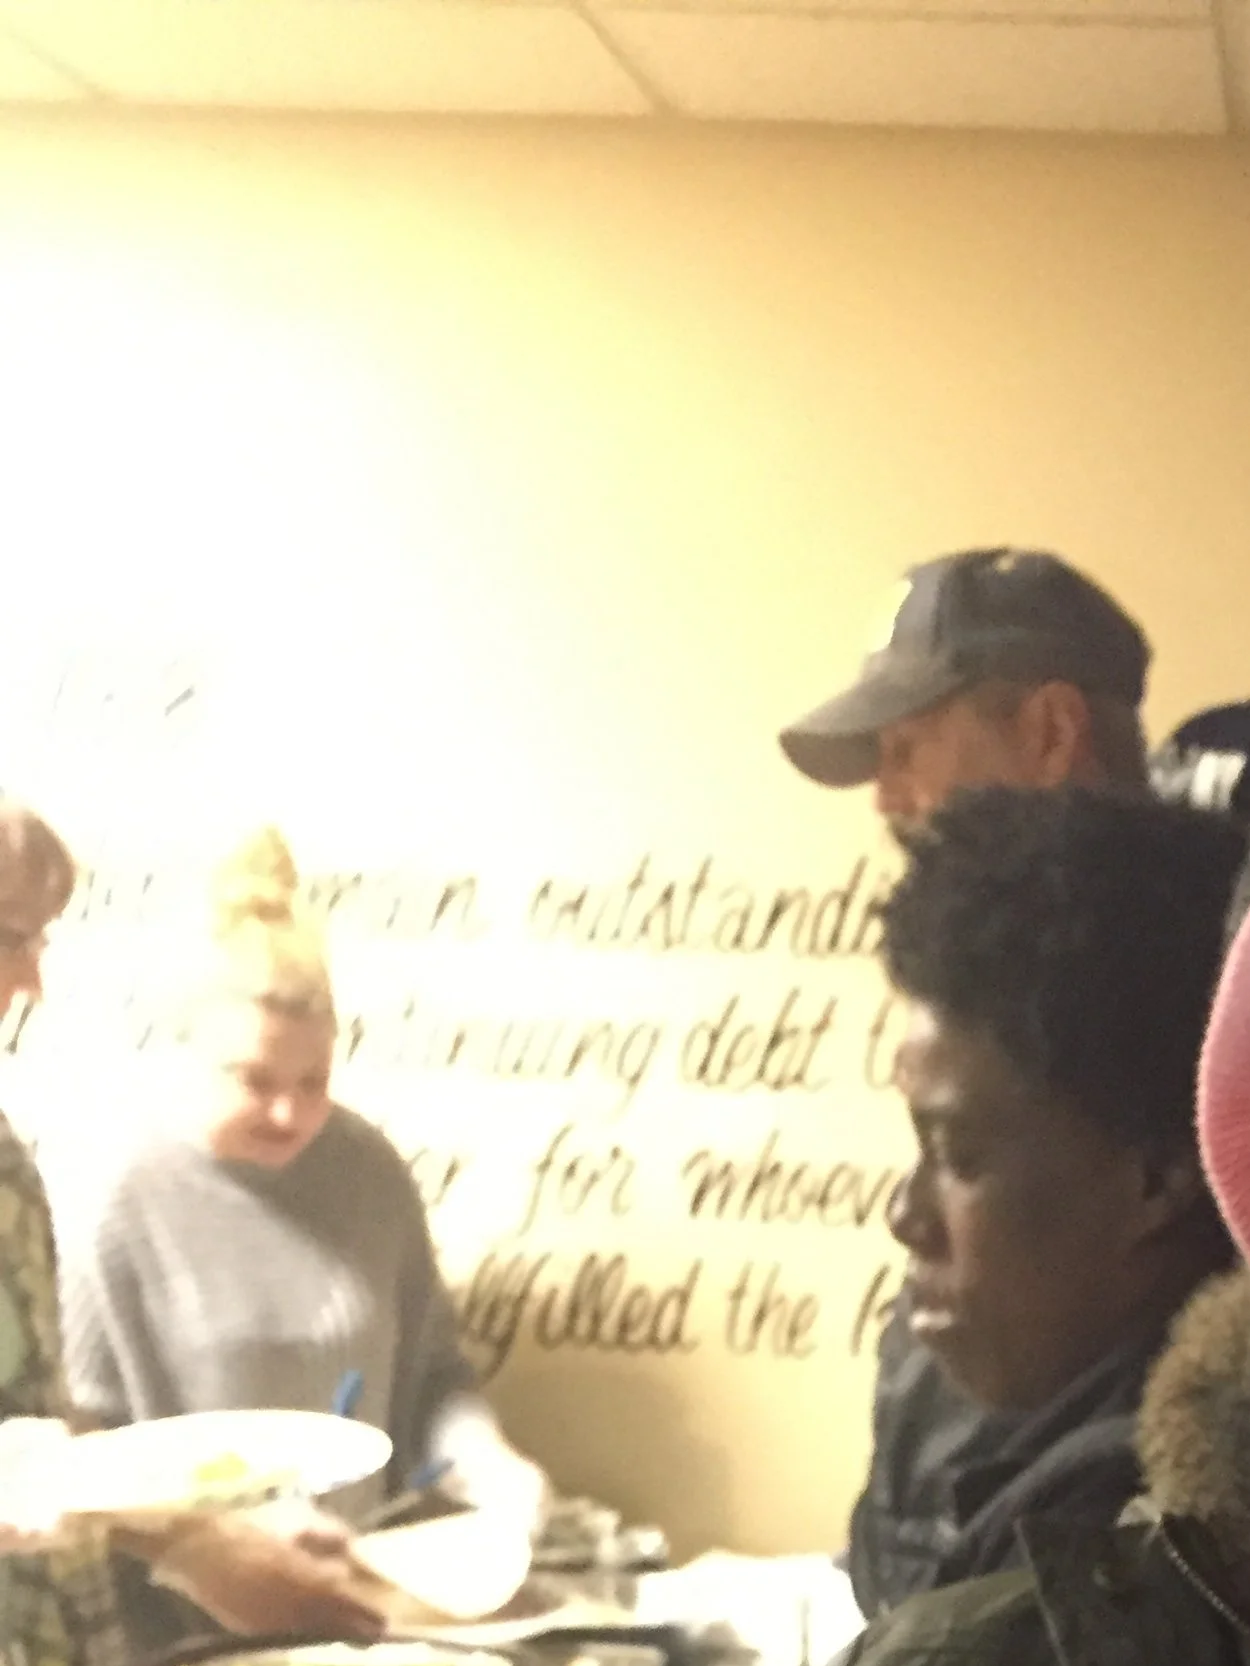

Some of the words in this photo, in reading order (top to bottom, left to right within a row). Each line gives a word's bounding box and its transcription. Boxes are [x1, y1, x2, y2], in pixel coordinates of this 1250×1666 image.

[529, 852, 892, 957] outstandi
[682, 985, 836, 1093] debt
[861, 994, 898, 1092] t
[516, 1122, 638, 1240] for
[680, 1128, 894, 1229] whoev
[724, 1262, 820, 1360] the
